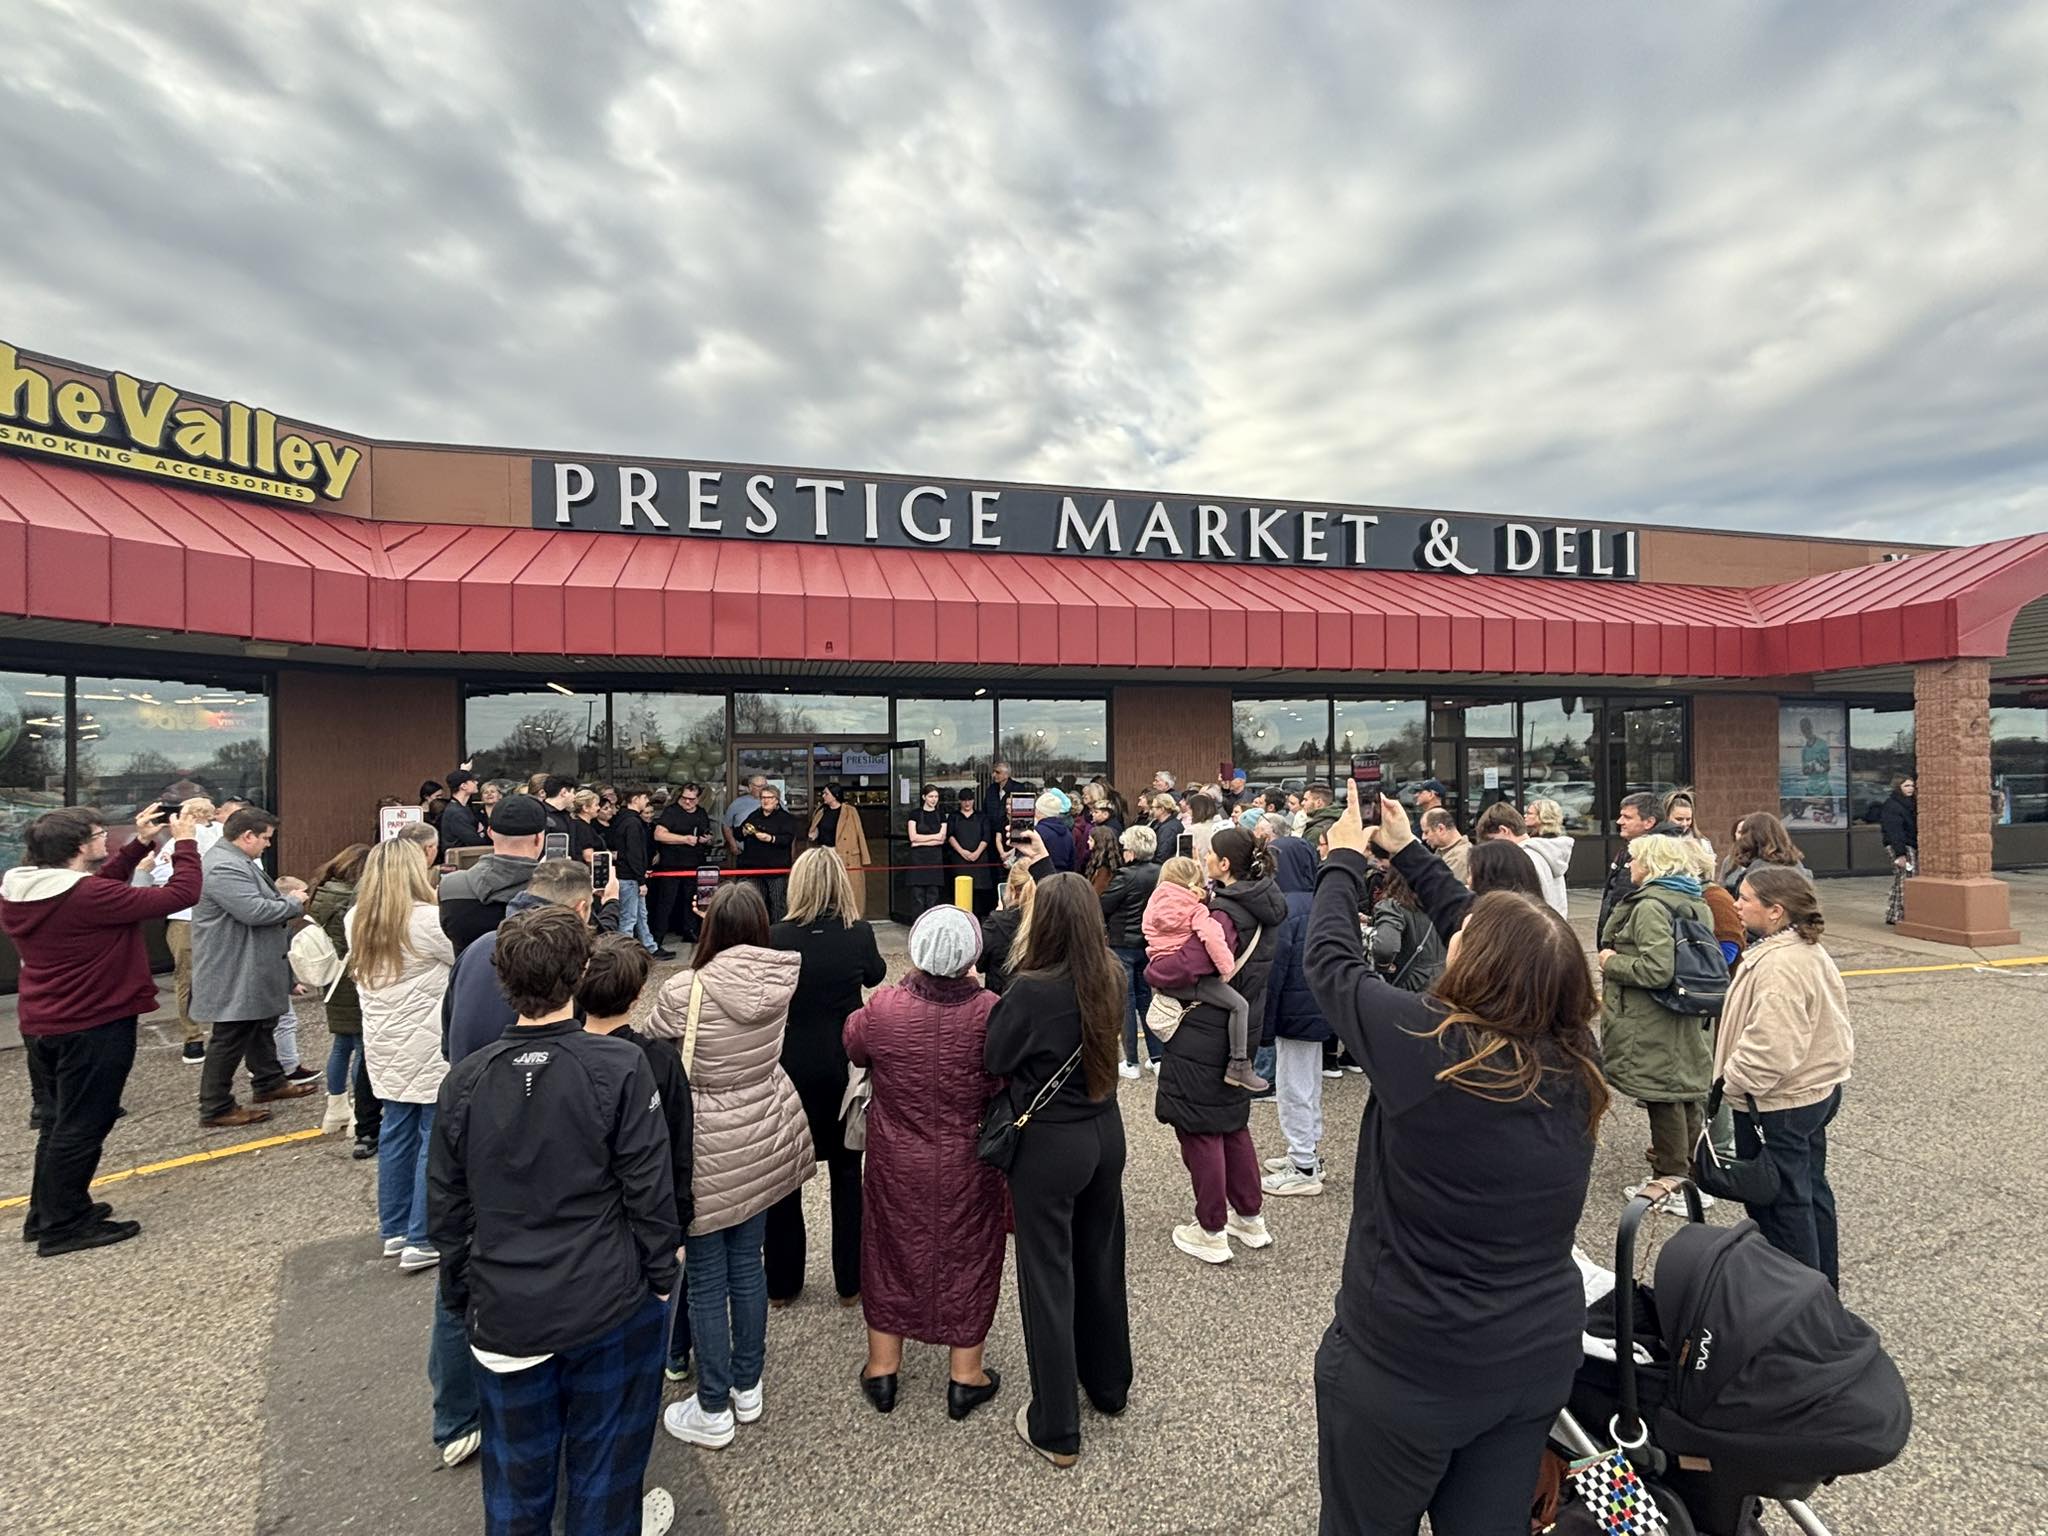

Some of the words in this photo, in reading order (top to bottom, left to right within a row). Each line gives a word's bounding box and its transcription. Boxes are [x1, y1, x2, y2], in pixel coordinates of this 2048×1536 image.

[0, 426, 132, 464] SMOKING
[155, 460, 305, 499] ACCESSORIES
[554, 463, 1002, 547] PRESTIGE
[1056, 496, 1379, 565] MARKET
[1423, 517, 1479, 576] &
[1506, 522, 1637, 577] DELI
[397, 810, 407, 819] NO
[1695, 1328, 1712, 1370] nuna
